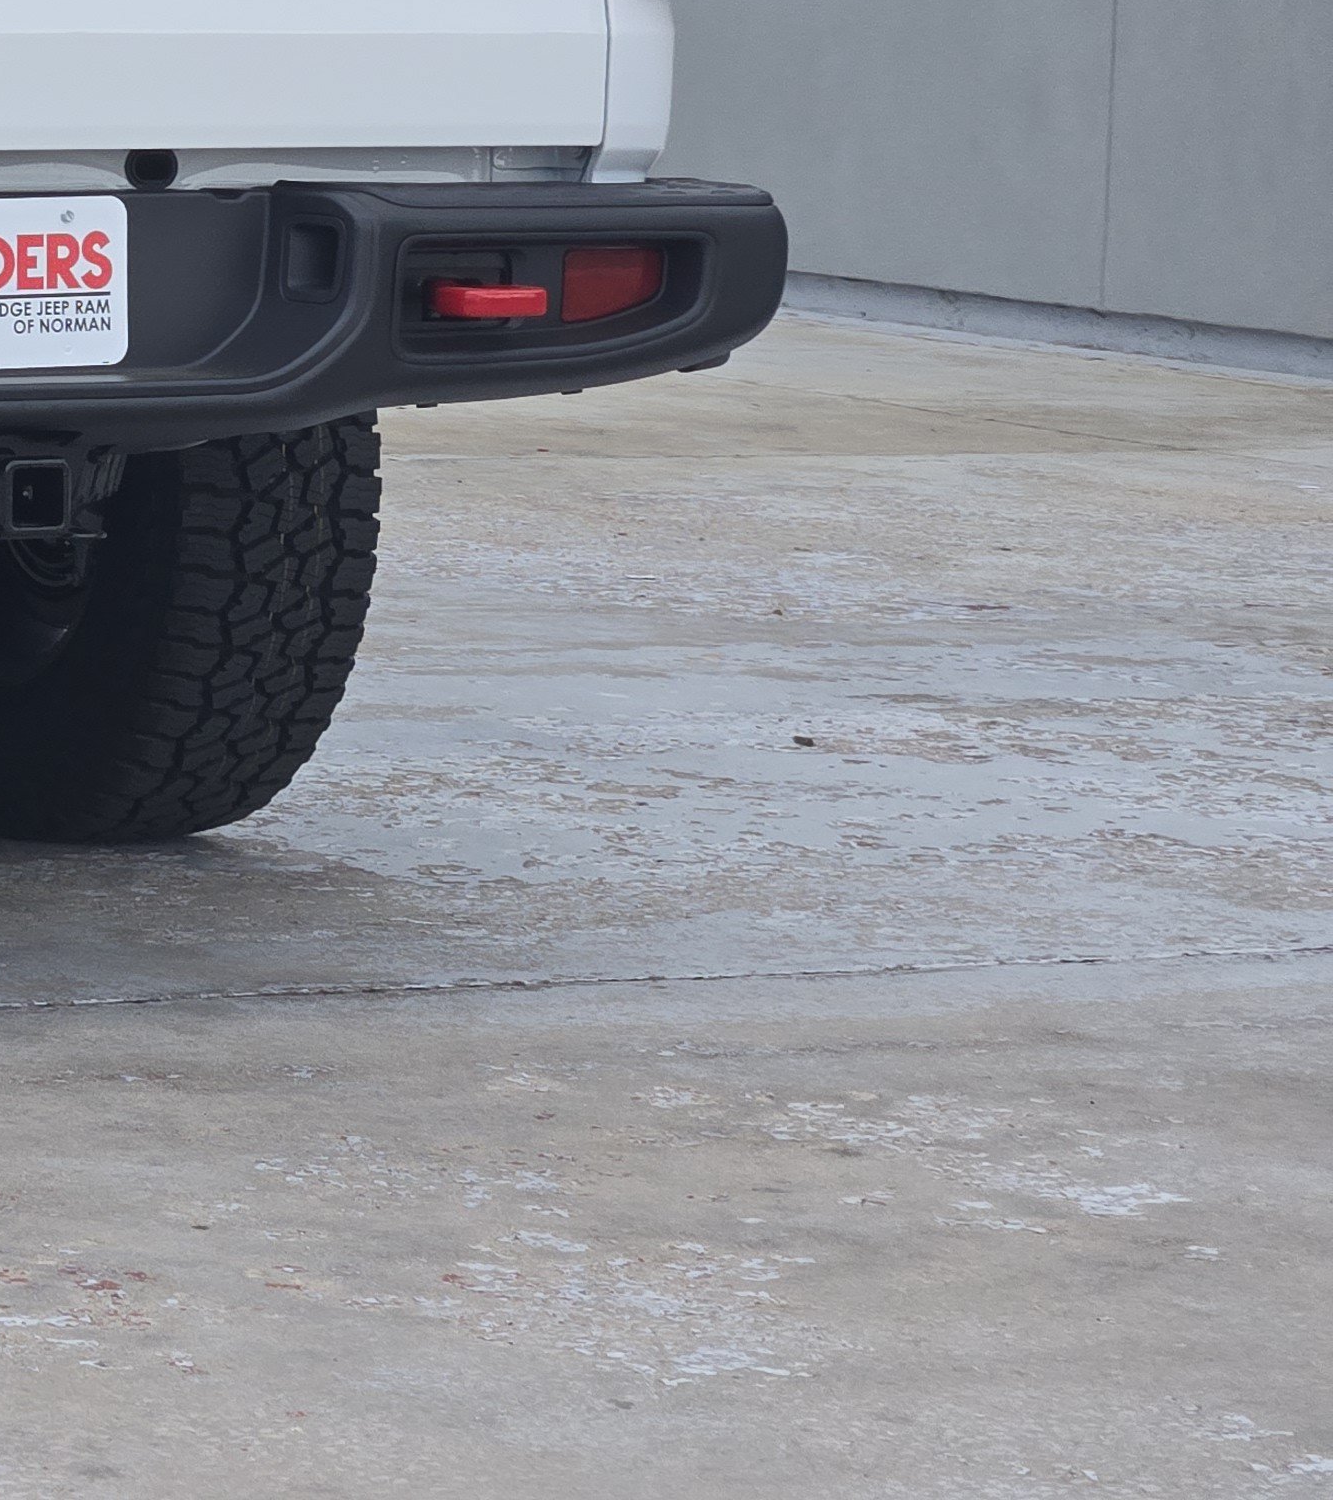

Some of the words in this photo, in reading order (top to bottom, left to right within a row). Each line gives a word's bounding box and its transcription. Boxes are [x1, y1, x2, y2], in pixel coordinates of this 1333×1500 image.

[36, 300, 69, 317] JEEP
[75, 299, 111, 315] RAM
[13, 319, 34, 334] OF
[39, 317, 111, 333] NORMAN
